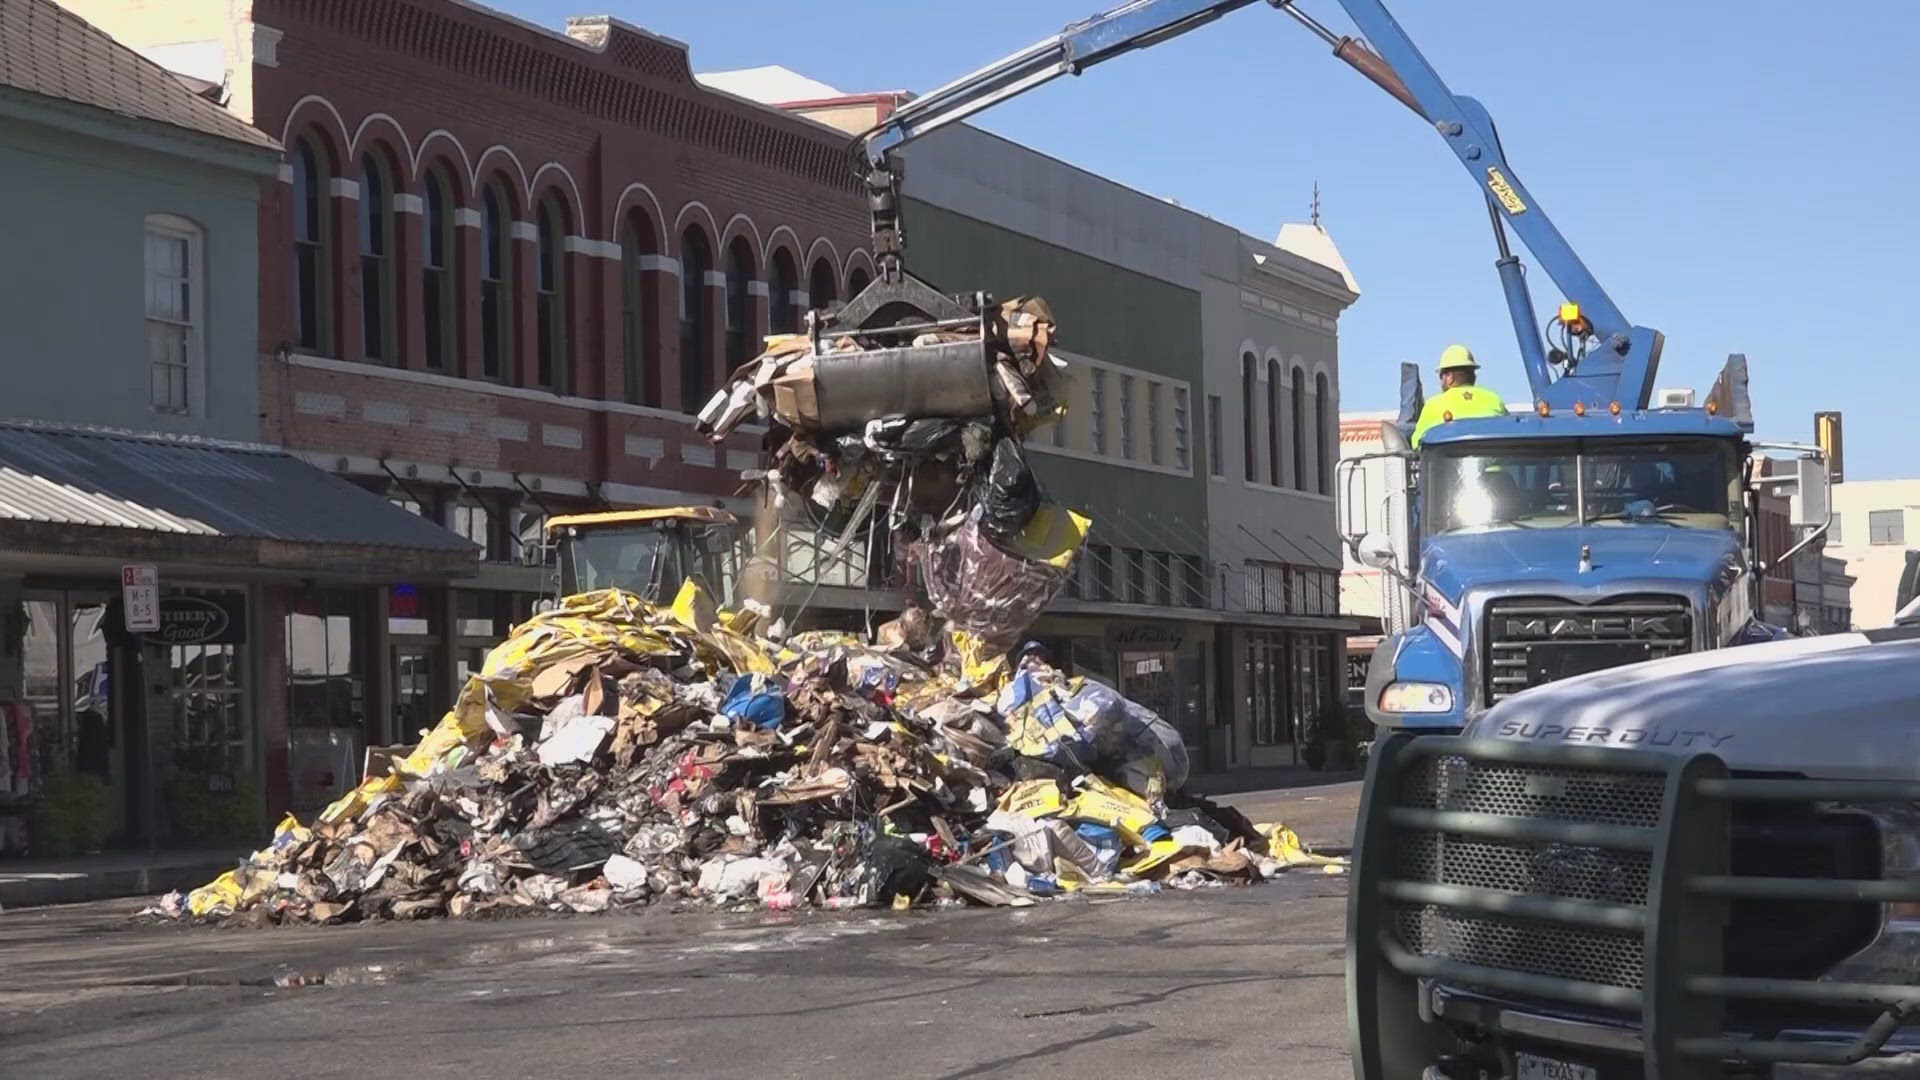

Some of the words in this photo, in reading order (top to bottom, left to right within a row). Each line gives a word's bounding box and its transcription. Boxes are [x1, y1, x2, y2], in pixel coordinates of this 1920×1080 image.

[125, 568, 132, 583] 2
[132, 589, 151, 602] M-F
[132, 603, 152, 617] 8-5
[164, 617, 210, 641] Good
[1506, 617, 1672, 636] MACK
[1498, 721, 1611, 743] SUPER
[1620, 724, 1735, 748] DUTY
[1542, 1062, 1575, 1080] TEXAS
